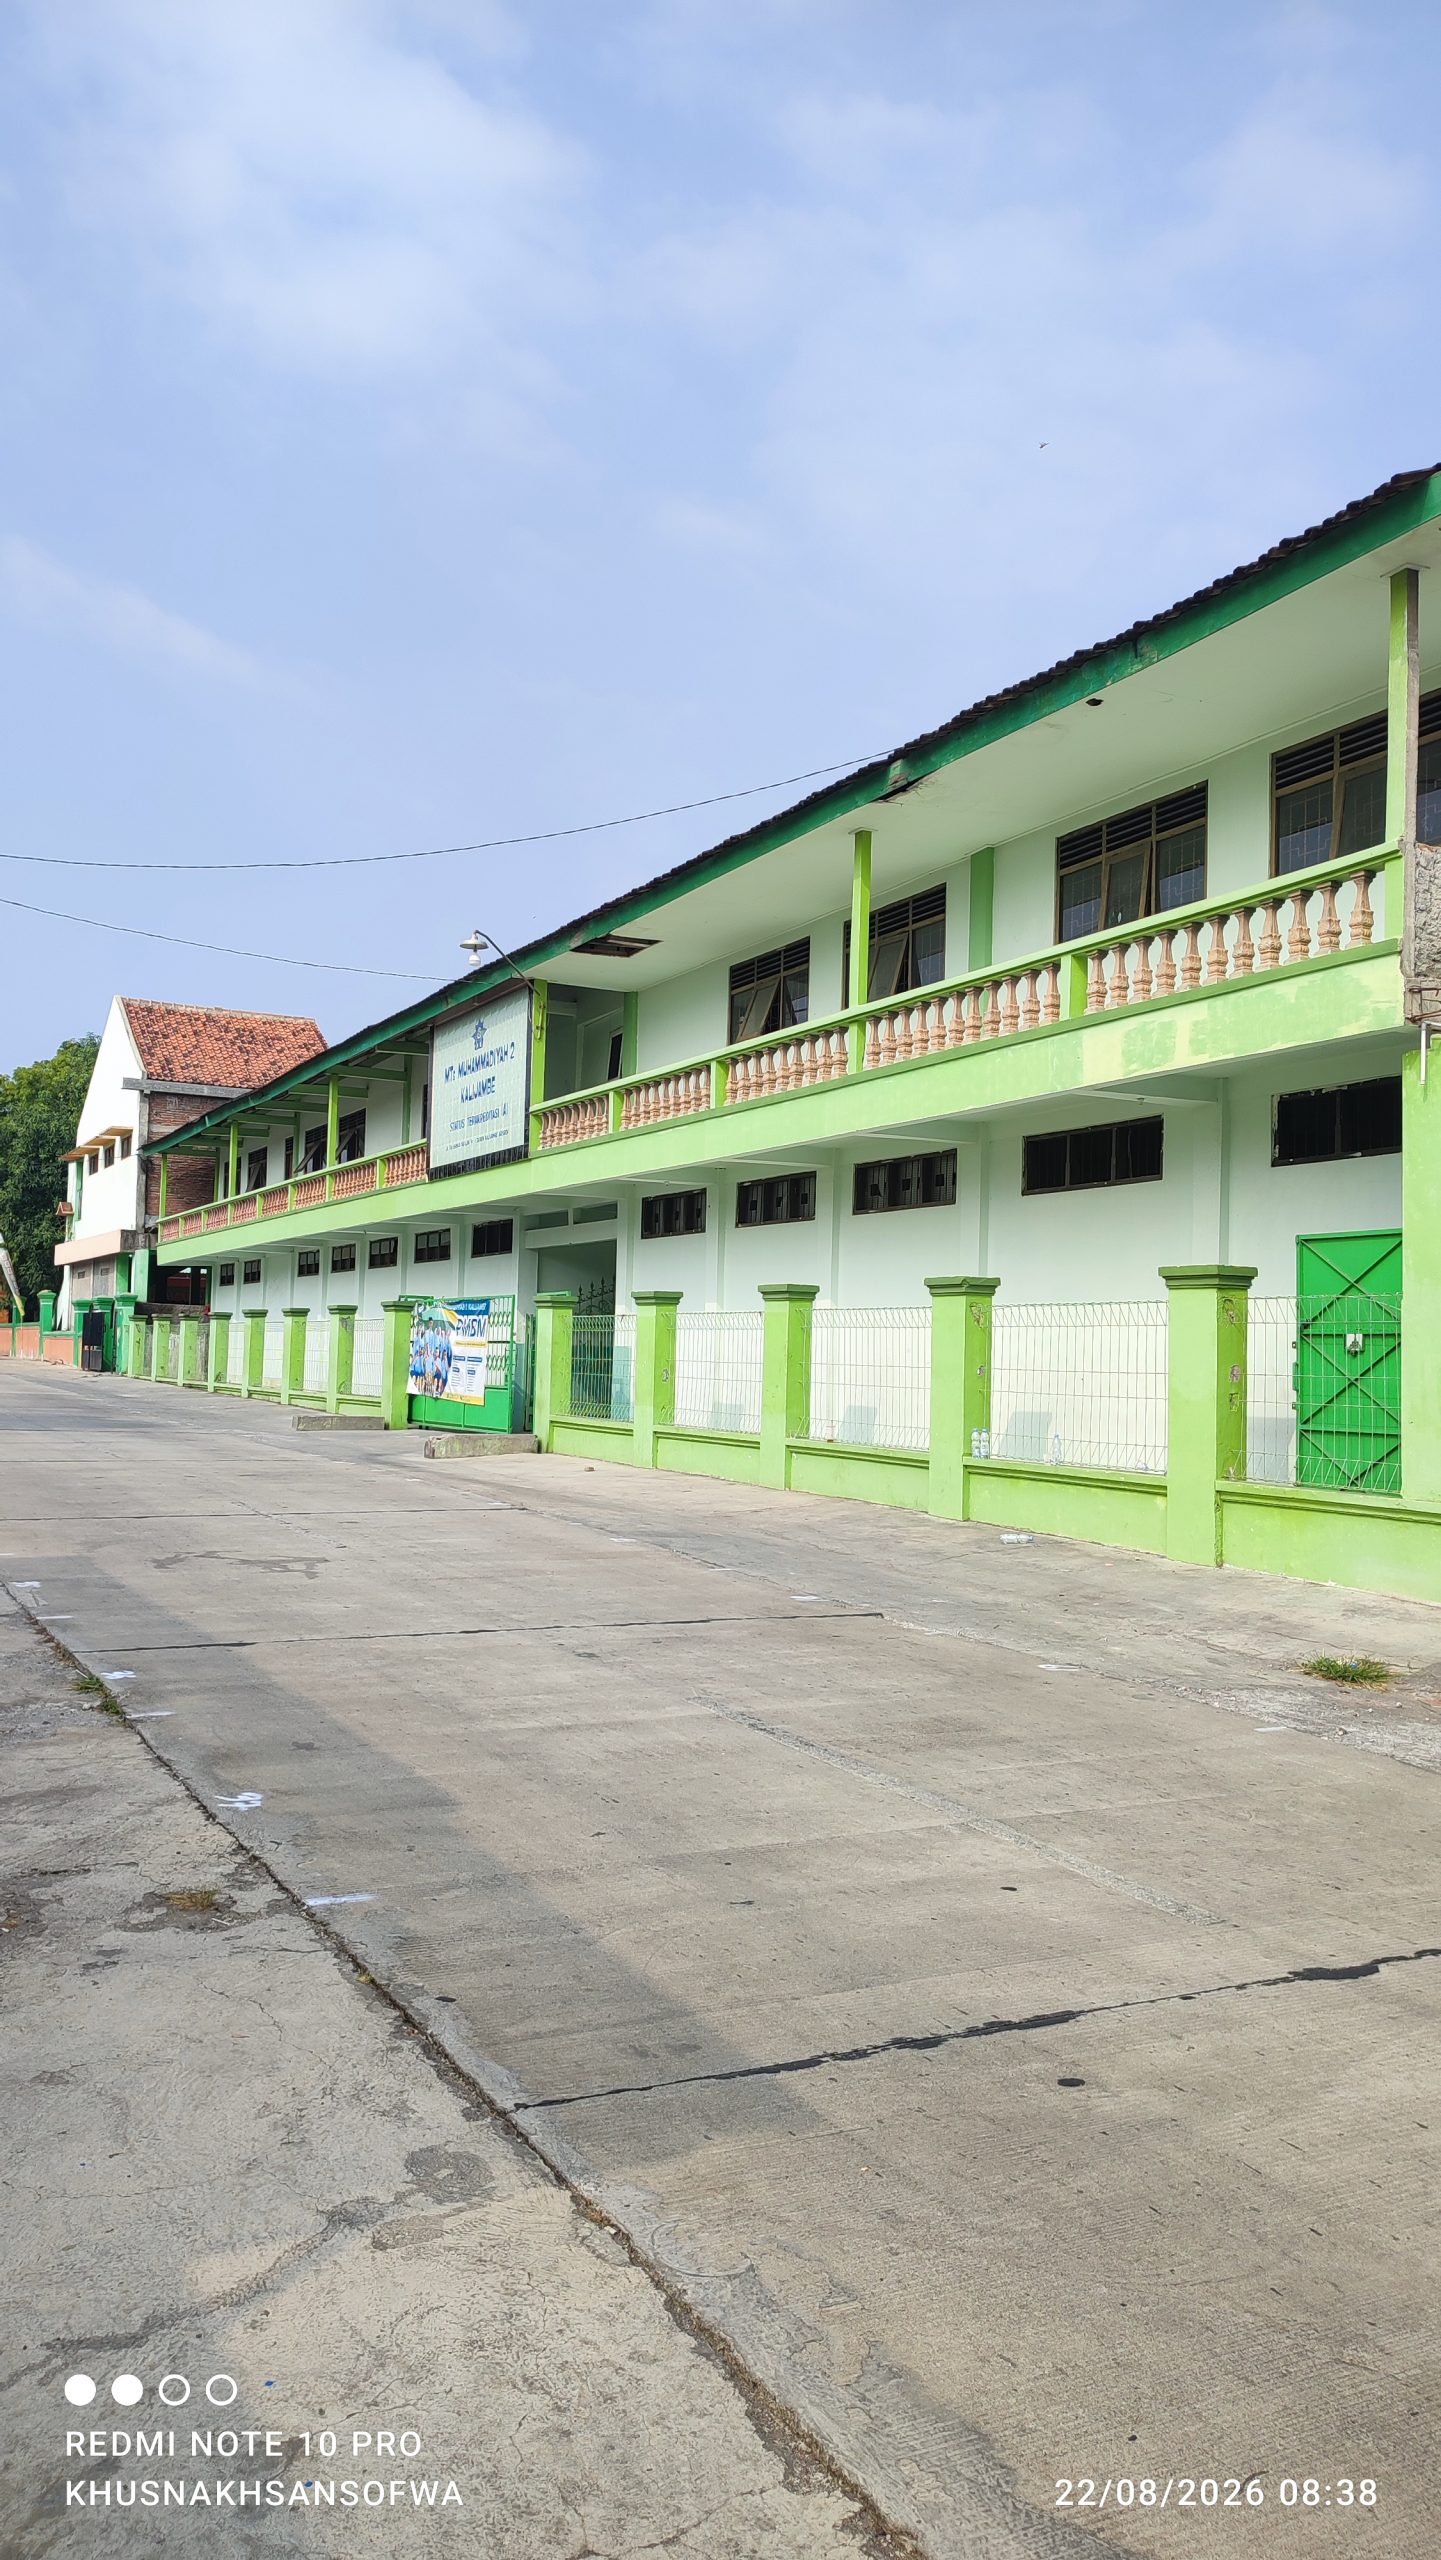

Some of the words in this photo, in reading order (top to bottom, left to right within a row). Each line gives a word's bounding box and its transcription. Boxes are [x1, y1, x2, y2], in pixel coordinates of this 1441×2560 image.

[458, 1043, 509, 1079] MUHAMMADIYAH
[510, 1041, 515, 1060] 2
[461, 1076, 496, 1104] KALIJAMBE
